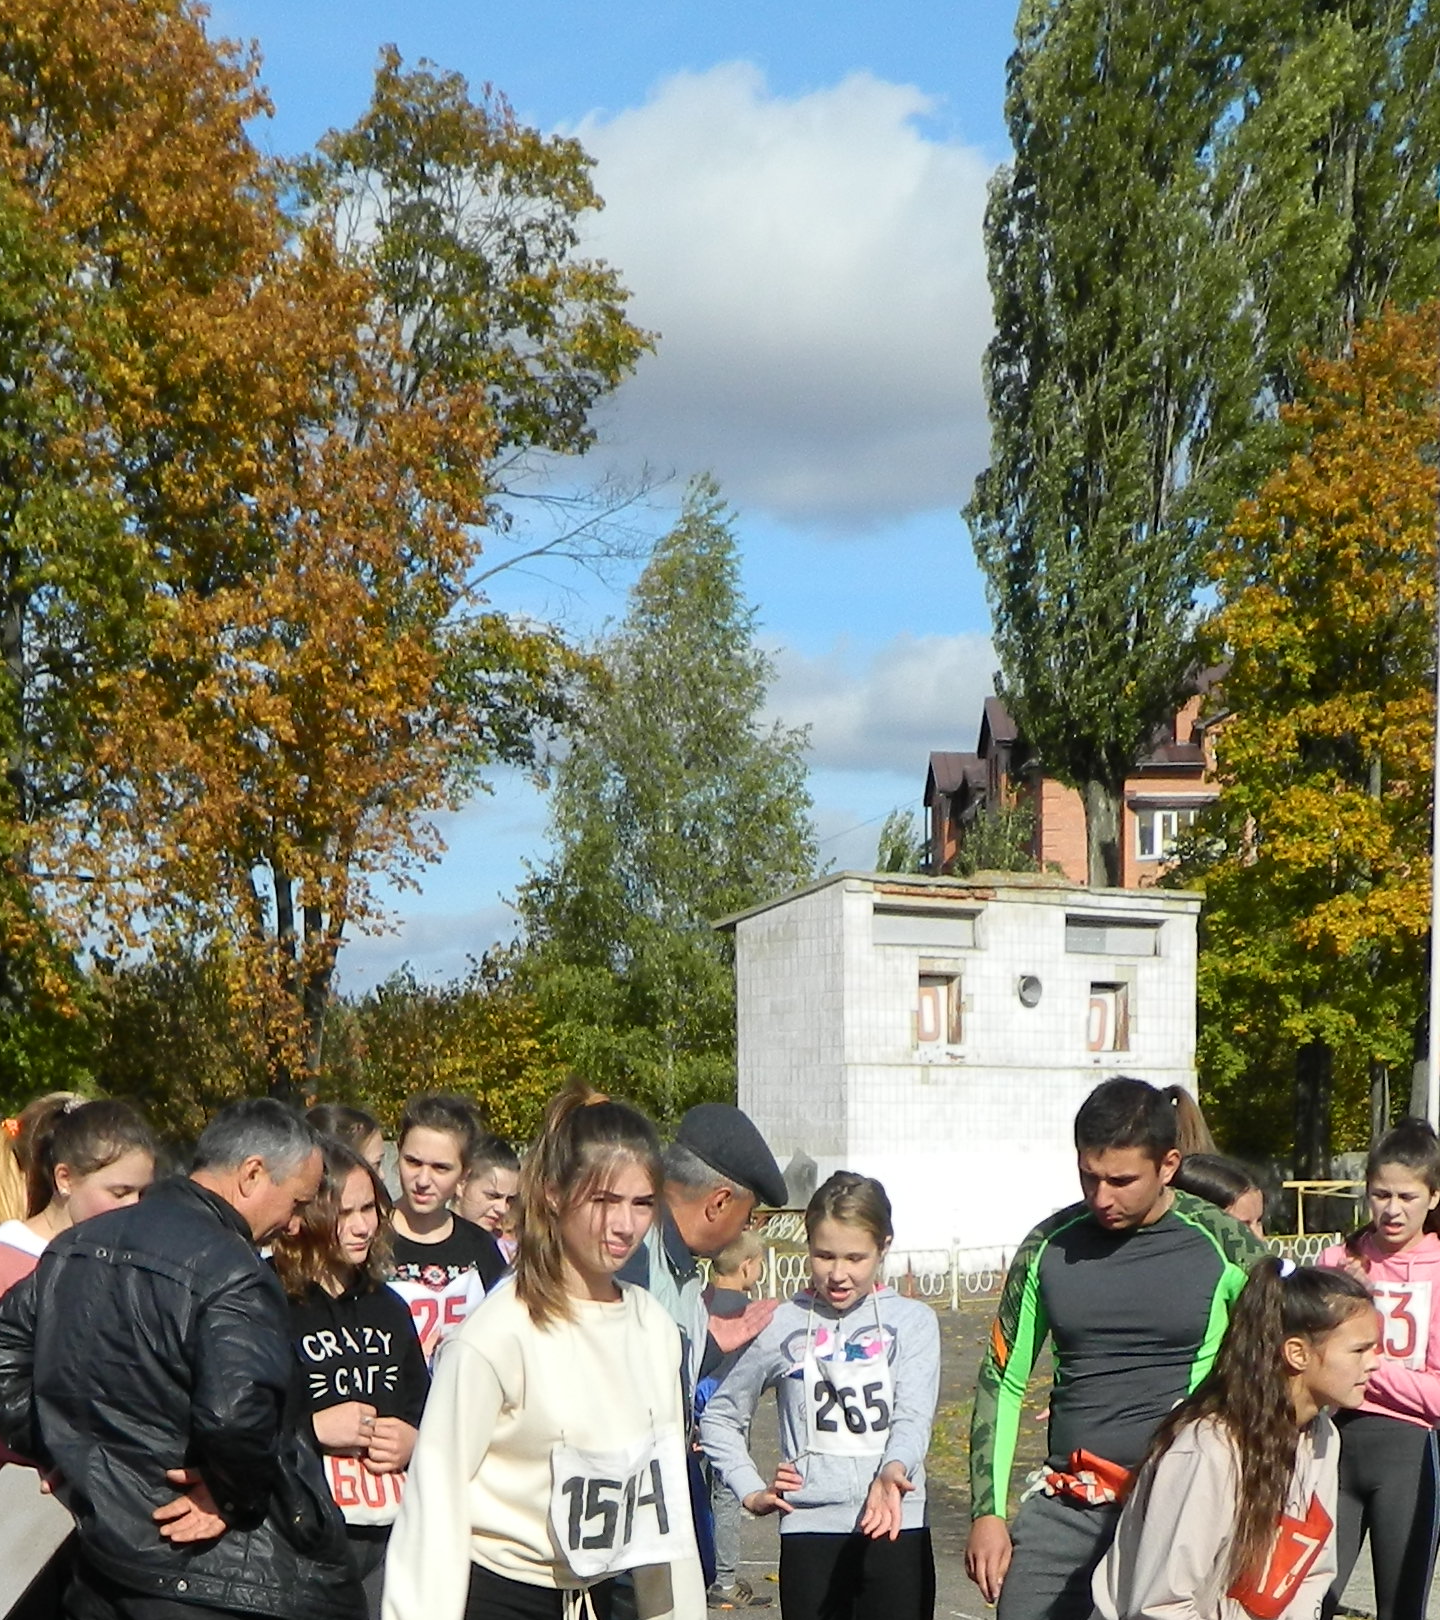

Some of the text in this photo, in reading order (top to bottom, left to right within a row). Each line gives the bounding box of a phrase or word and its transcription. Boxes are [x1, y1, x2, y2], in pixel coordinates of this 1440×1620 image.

[302, 1326, 392, 1362] CRAZY
[335, 1365, 380, 1396] CAT
[814, 1379, 890, 1434] 265
[562, 1459, 669, 1550] 1514
